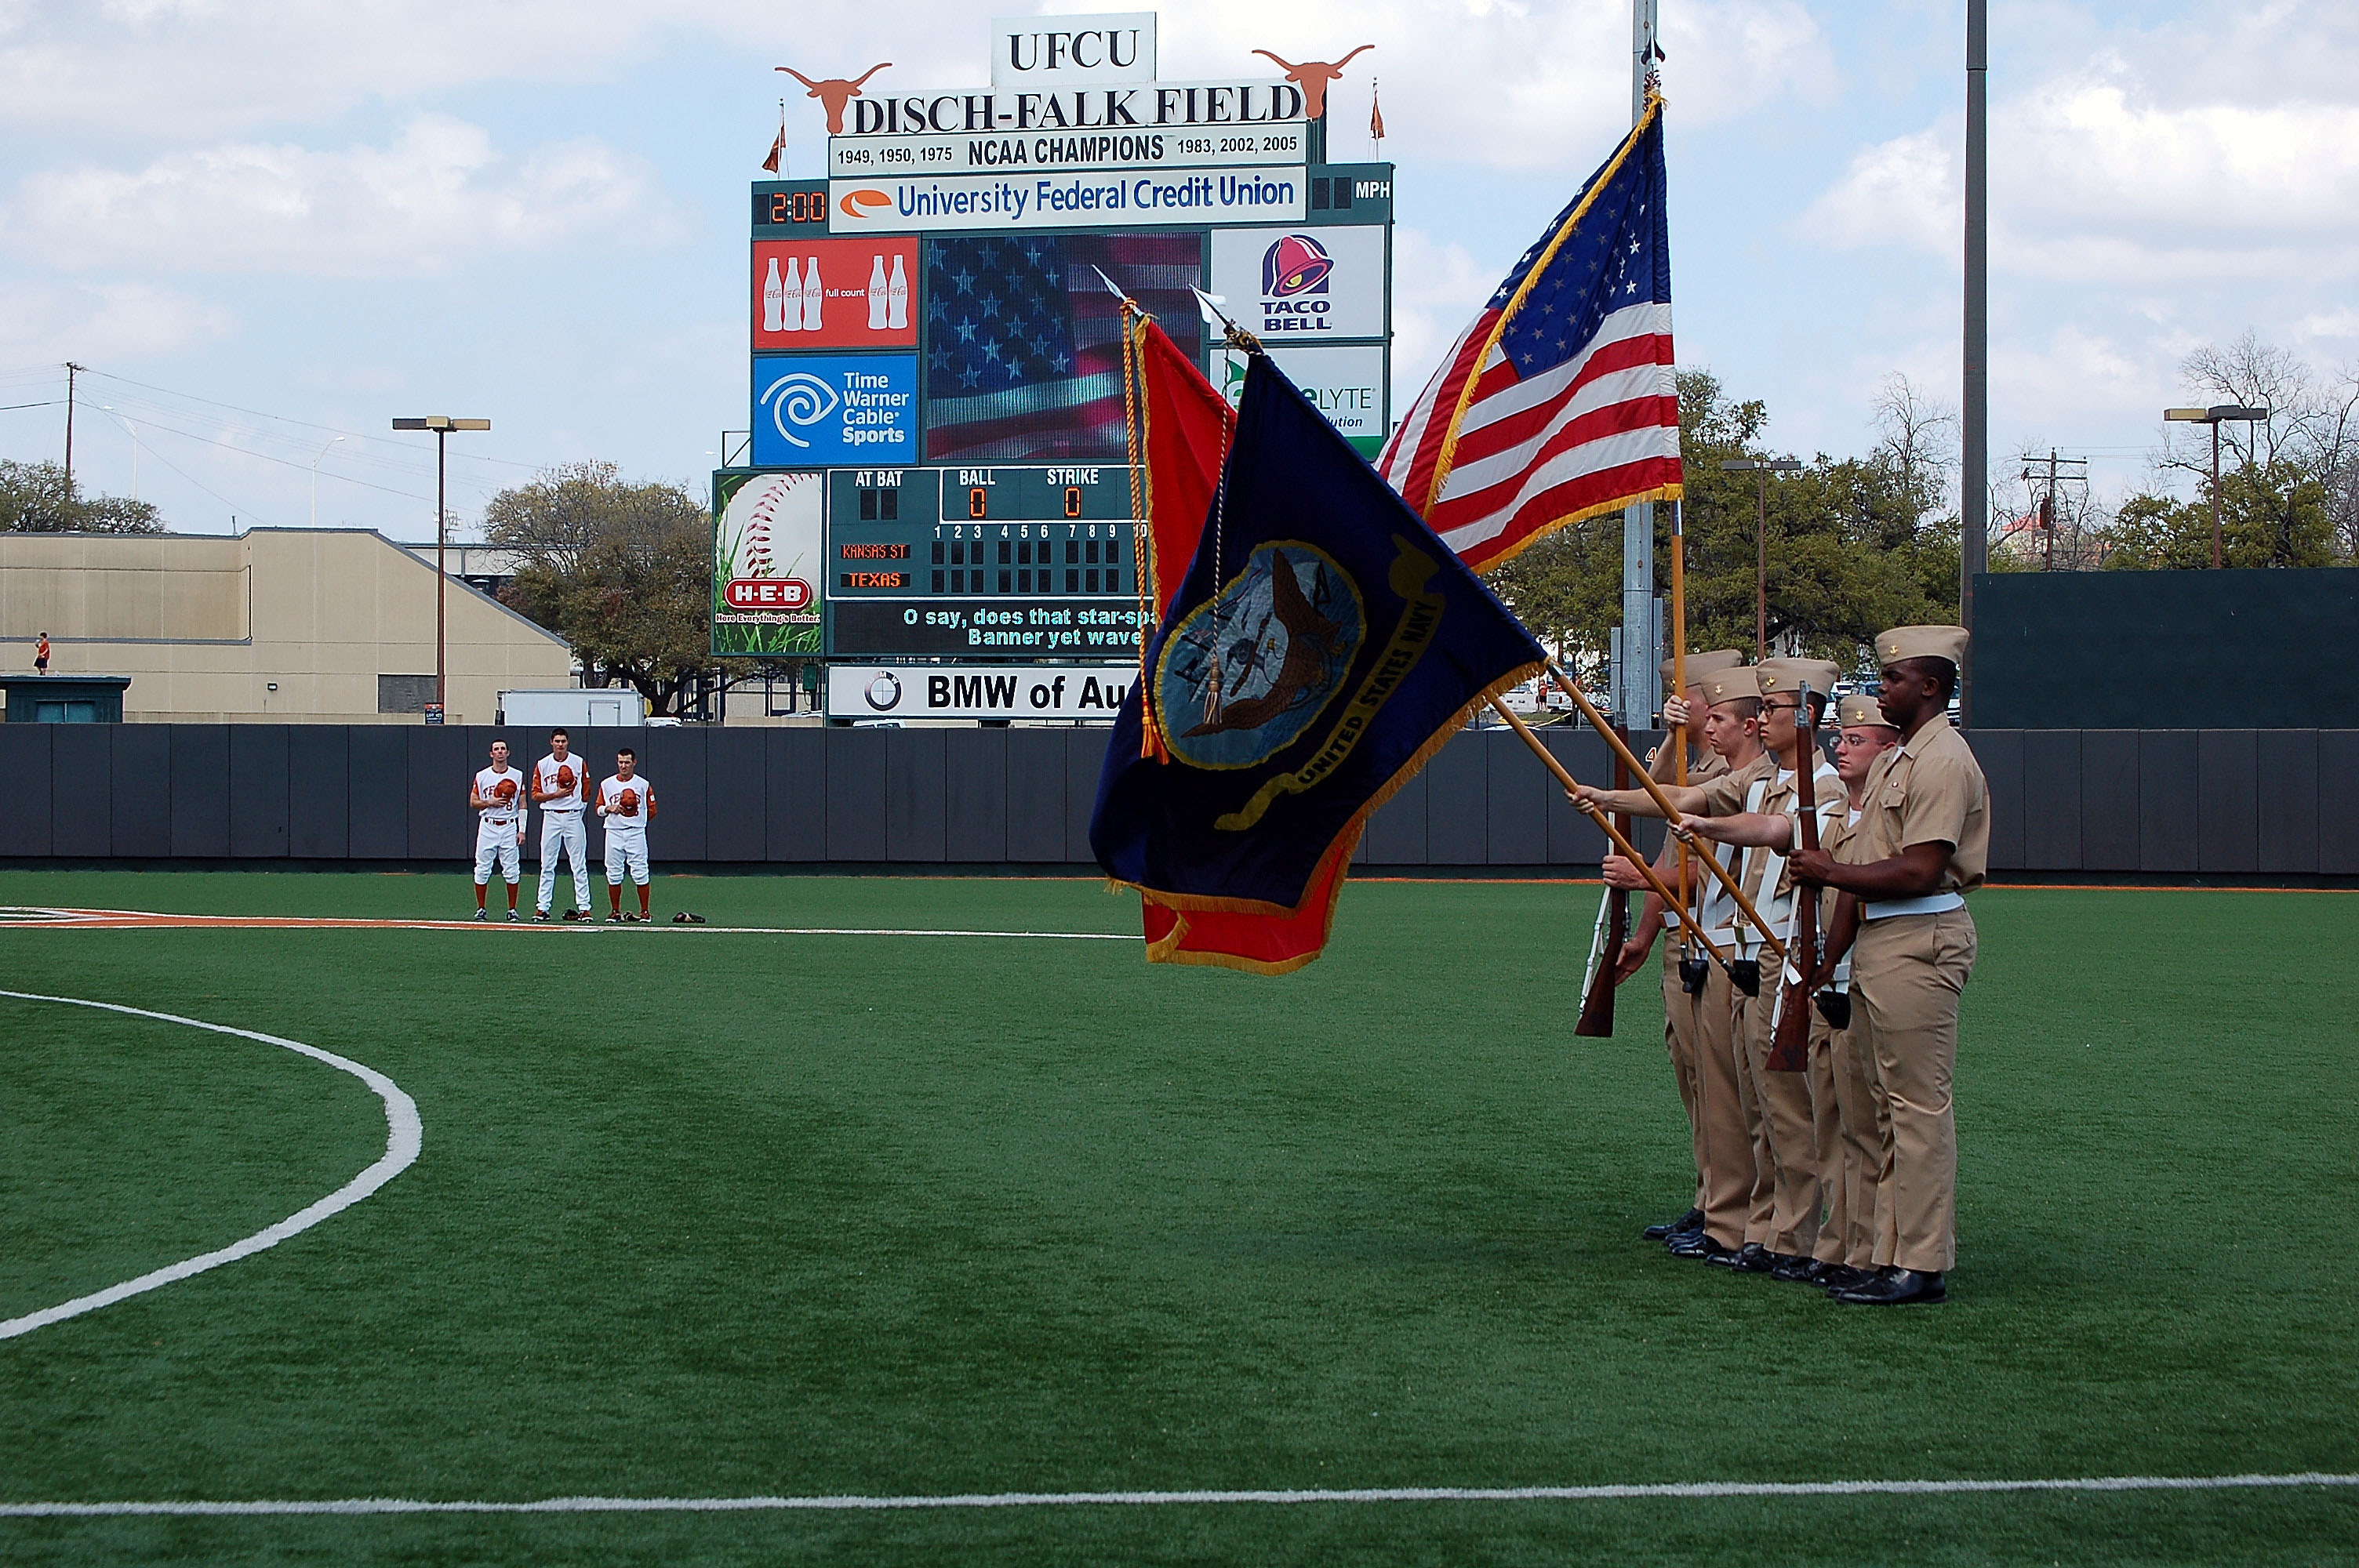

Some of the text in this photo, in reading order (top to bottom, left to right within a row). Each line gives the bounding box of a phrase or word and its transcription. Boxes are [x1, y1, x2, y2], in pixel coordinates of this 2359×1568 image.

[1007, 29, 1140, 71] UFCU
[852, 85, 1303, 135] DISCH-FALK FIELD
[838, 134, 1297, 167] 1949, 1950, 1975 NCAA CHAMPIONS 1983, 2002, 2005
[898, 175, 1293, 220] University Federal Credit Union
[1355, 181, 1390, 199] MPH
[772, 192, 825, 222] 2:00
[825, 289, 838, 297] full
[841, 289, 865, 297] count
[1260, 300, 1331, 315] TACO
[1264, 318, 1332, 332] BELL
[843, 372, 889, 389] Time
[843, 390, 910, 407] Warner
[842, 408, 894, 425] Cable
[842, 426, 905, 446] Sports
[855, 471, 903, 487] AT BAT
[959, 470, 996, 485] BALL
[1047, 469, 1099, 485] STRIKE
[970, 488, 985, 517] 0
[1065, 488, 1080, 516] 0
[934, 525, 941, 539] 1
[954, 525, 962, 539] 2
[973, 525, 982, 539] 3
[1001, 525, 1009, 538] 4
[1020, 524, 1029, 538] 5
[1040, 524, 1049, 538] 6
[1069, 524, 1076, 537] 7
[1089, 524, 1096, 537] 8
[1109, 524, 1116, 537] 9
[843, 545, 907, 558] KANSAS ST
[849, 573, 901, 586] TEXAS
[904, 609, 917, 624] O
[925, 610, 967, 629] say,
[973, 608, 1025, 625] does
[1029, 608, 1071, 624] that
[969, 629, 1142, 649] Banner yet wave
[929, 675, 1018, 708] BMW
[1029, 676, 1066, 708] of
[1298, 600, 1438, 783] UNITED STATES NAVY
